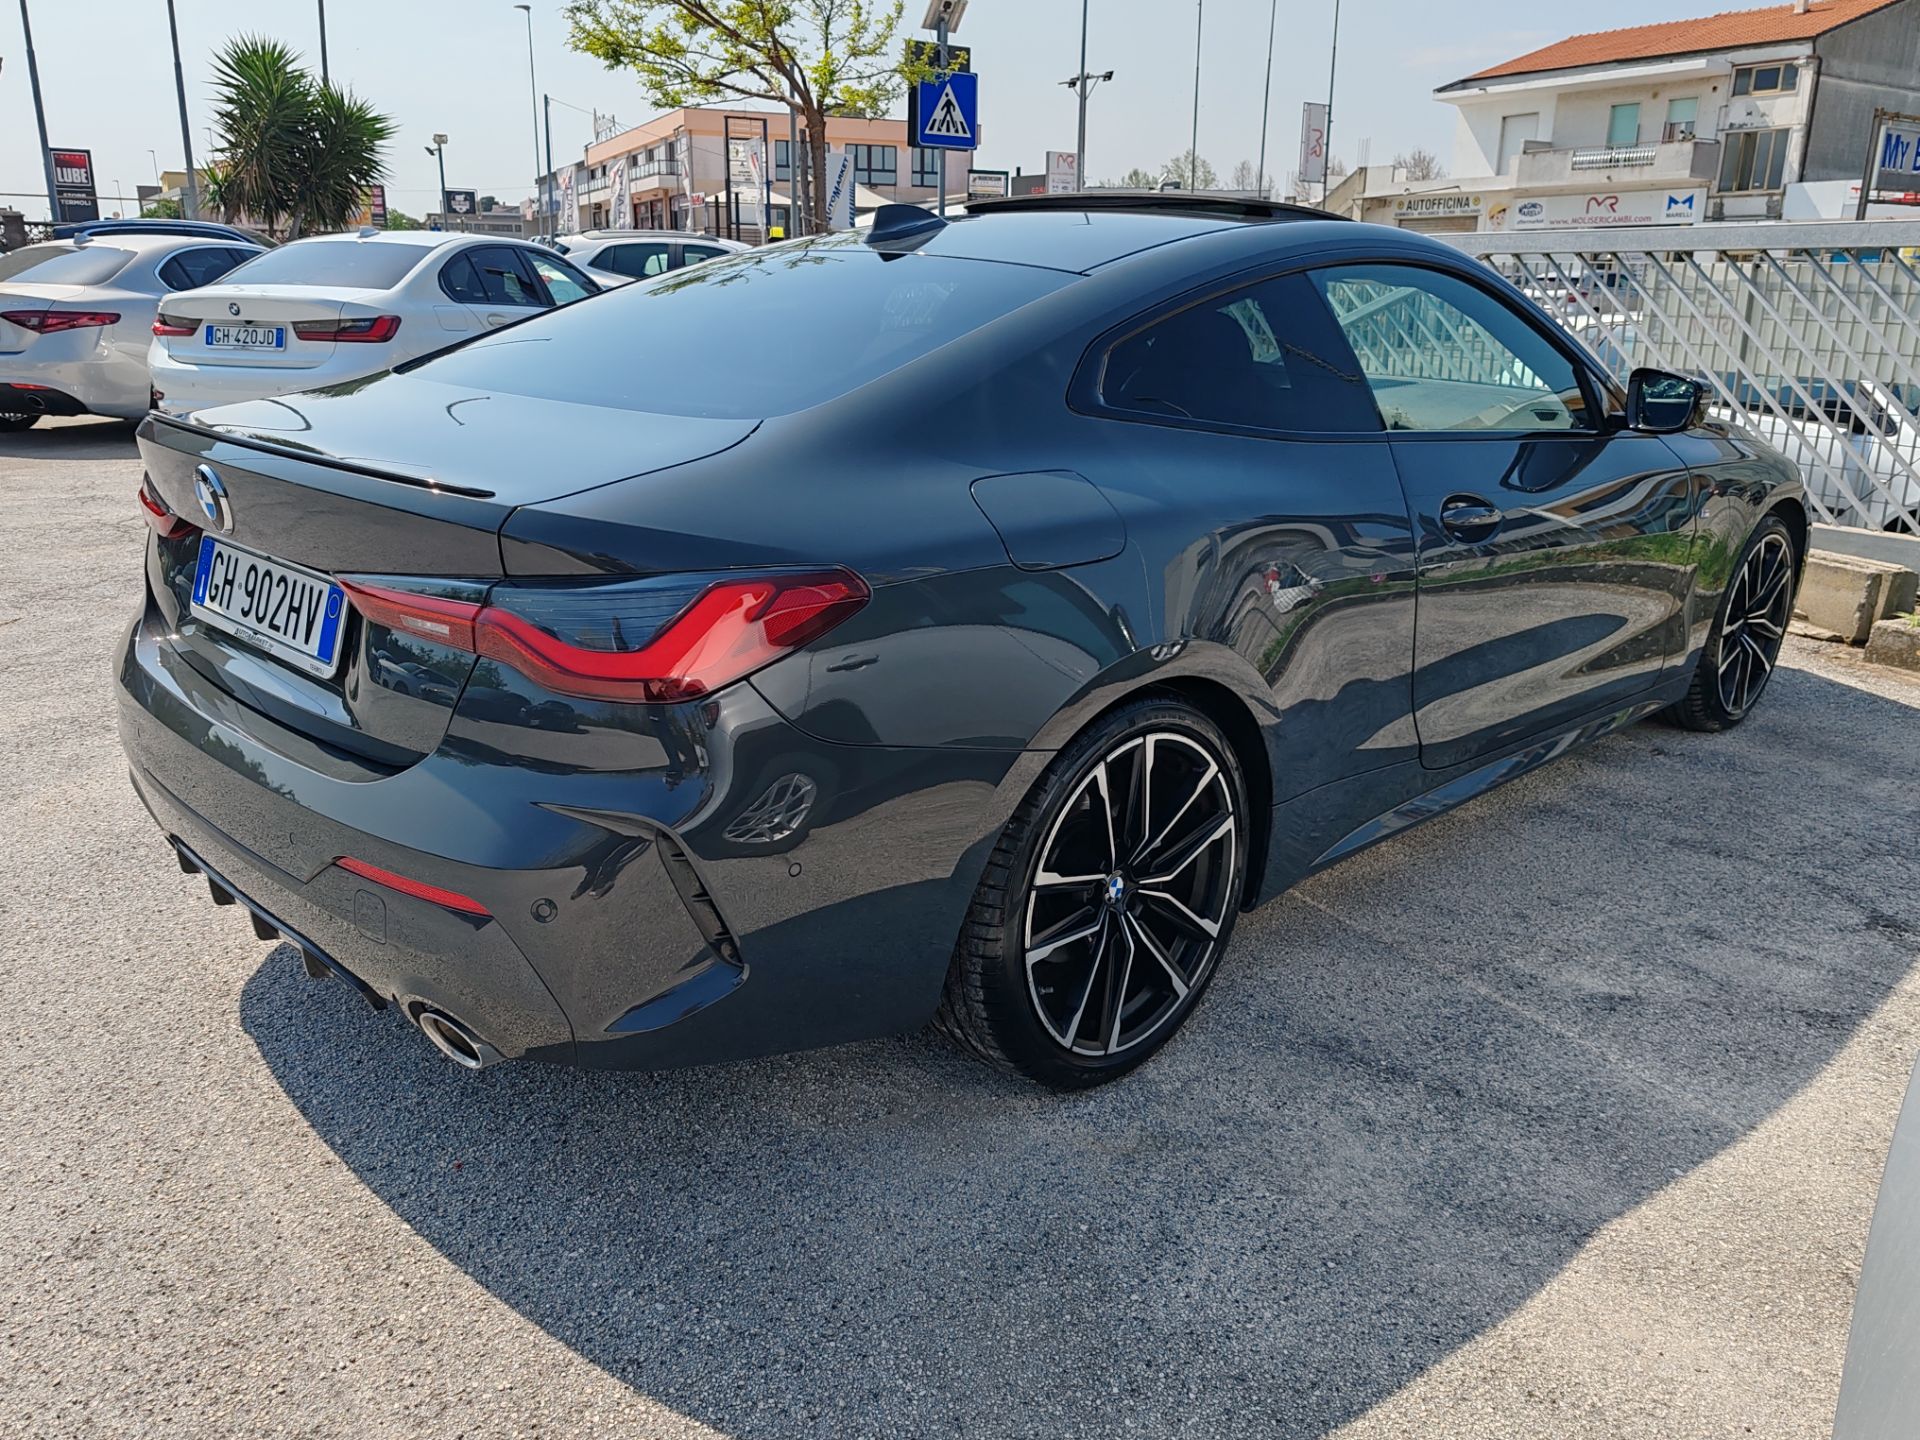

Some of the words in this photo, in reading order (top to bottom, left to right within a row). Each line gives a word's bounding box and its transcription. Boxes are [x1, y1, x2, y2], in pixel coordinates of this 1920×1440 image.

[56, 167, 88, 183] LUBE
[1405, 196, 1470, 212] AUTOFFICINA
[208, 550, 239, 610] GH
[240, 563, 324, 645] 902HV
